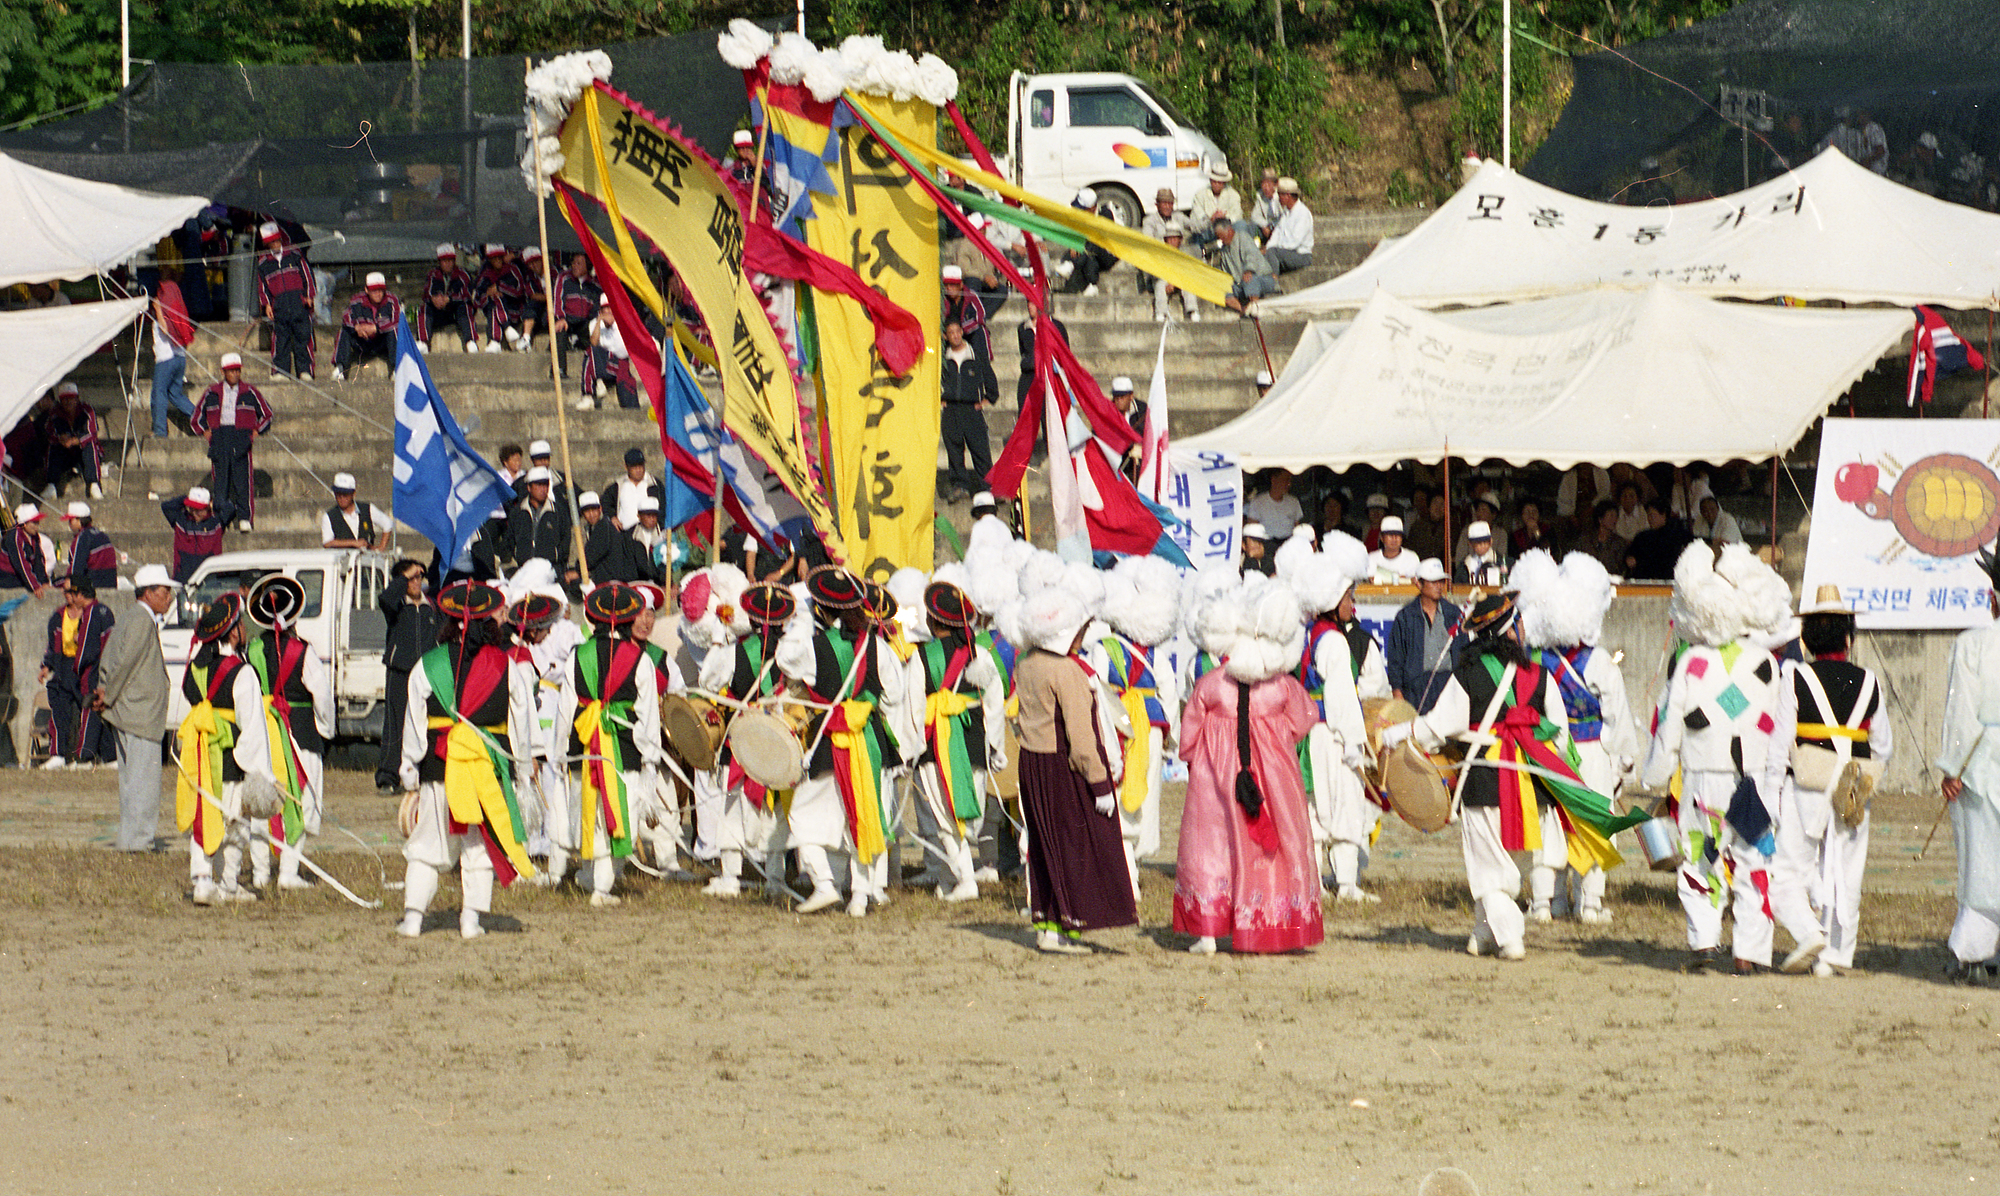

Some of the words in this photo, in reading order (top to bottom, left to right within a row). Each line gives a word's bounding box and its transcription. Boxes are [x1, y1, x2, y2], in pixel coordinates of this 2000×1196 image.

[1198, 452, 1237, 560] 오늘의
[1844, 586, 1912, 612] 구천면
[1926, 587, 1992, 612] 체육회
